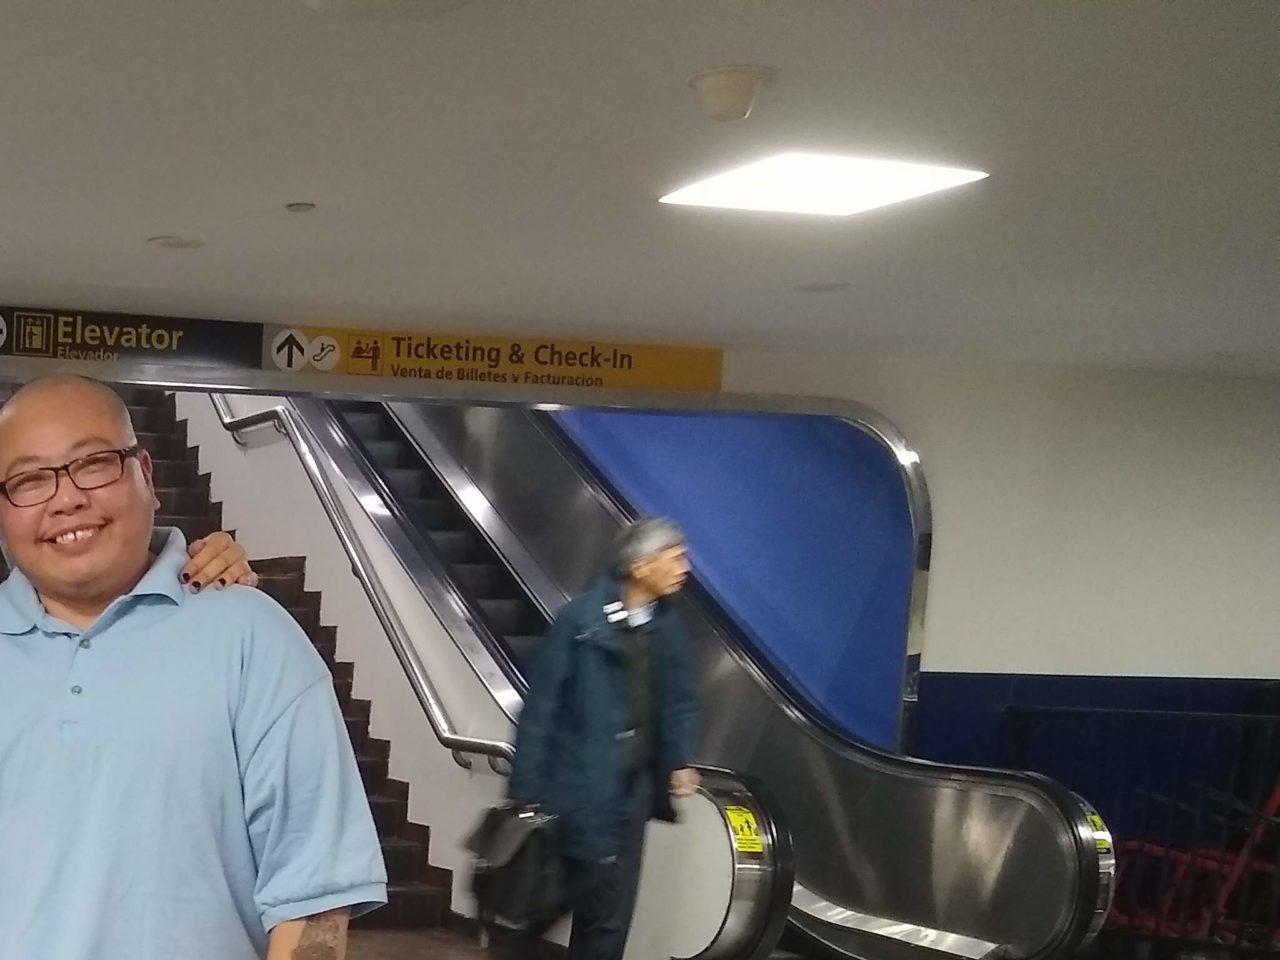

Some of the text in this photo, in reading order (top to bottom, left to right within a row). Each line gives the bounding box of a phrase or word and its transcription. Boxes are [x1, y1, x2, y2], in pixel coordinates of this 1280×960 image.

[57, 316, 183, 350] Elevator
[57, 346, 120, 361] Elevador
[391, 336, 633, 369] Ticketing & Check-In
[391, 364, 432, 379] Venta
[436, 366, 453, 380] de
[457, 367, 508, 383] Billetes
